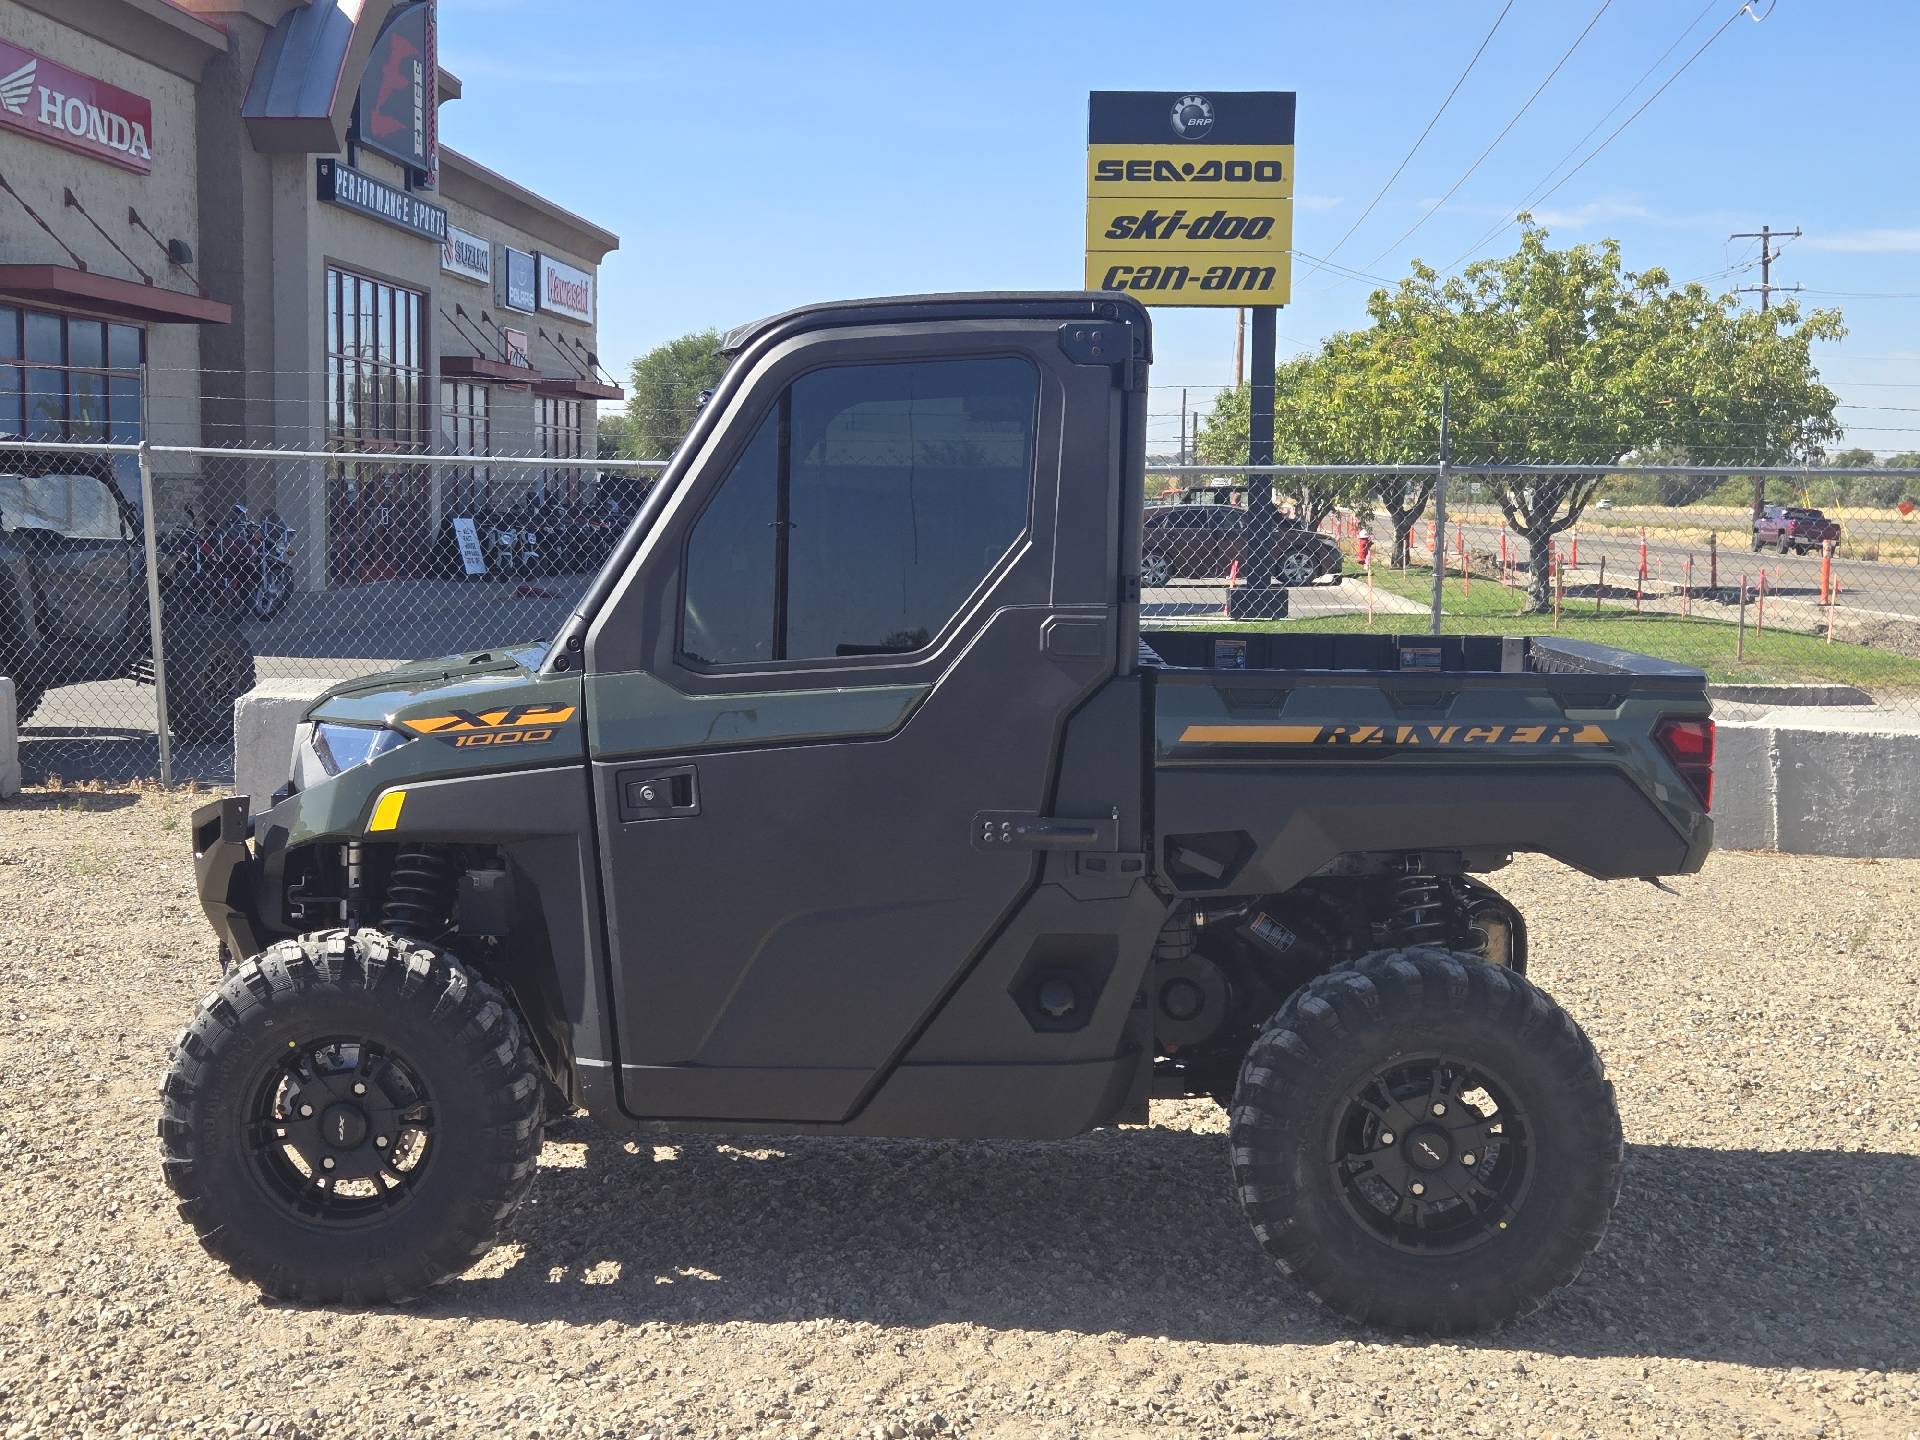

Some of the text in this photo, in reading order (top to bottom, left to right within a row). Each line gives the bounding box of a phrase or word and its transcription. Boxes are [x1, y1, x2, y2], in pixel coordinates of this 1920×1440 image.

[37, 84, 151, 160] HONDA
[1187, 118, 1212, 126] BRP
[336, 167, 445, 236] PERFORMANCE SPORTS
[455, 240, 488, 275] SUZUKI
[547, 266, 588, 314] Kawasaki
[1101, 266, 1276, 291] can-am
[509, 287, 535, 307] POLARIS
[430, 702, 569, 731] XP
[455, 729, 552, 747] 1000
[1313, 724, 1588, 744] RANGER
[338, 1115, 346, 1141] XP
